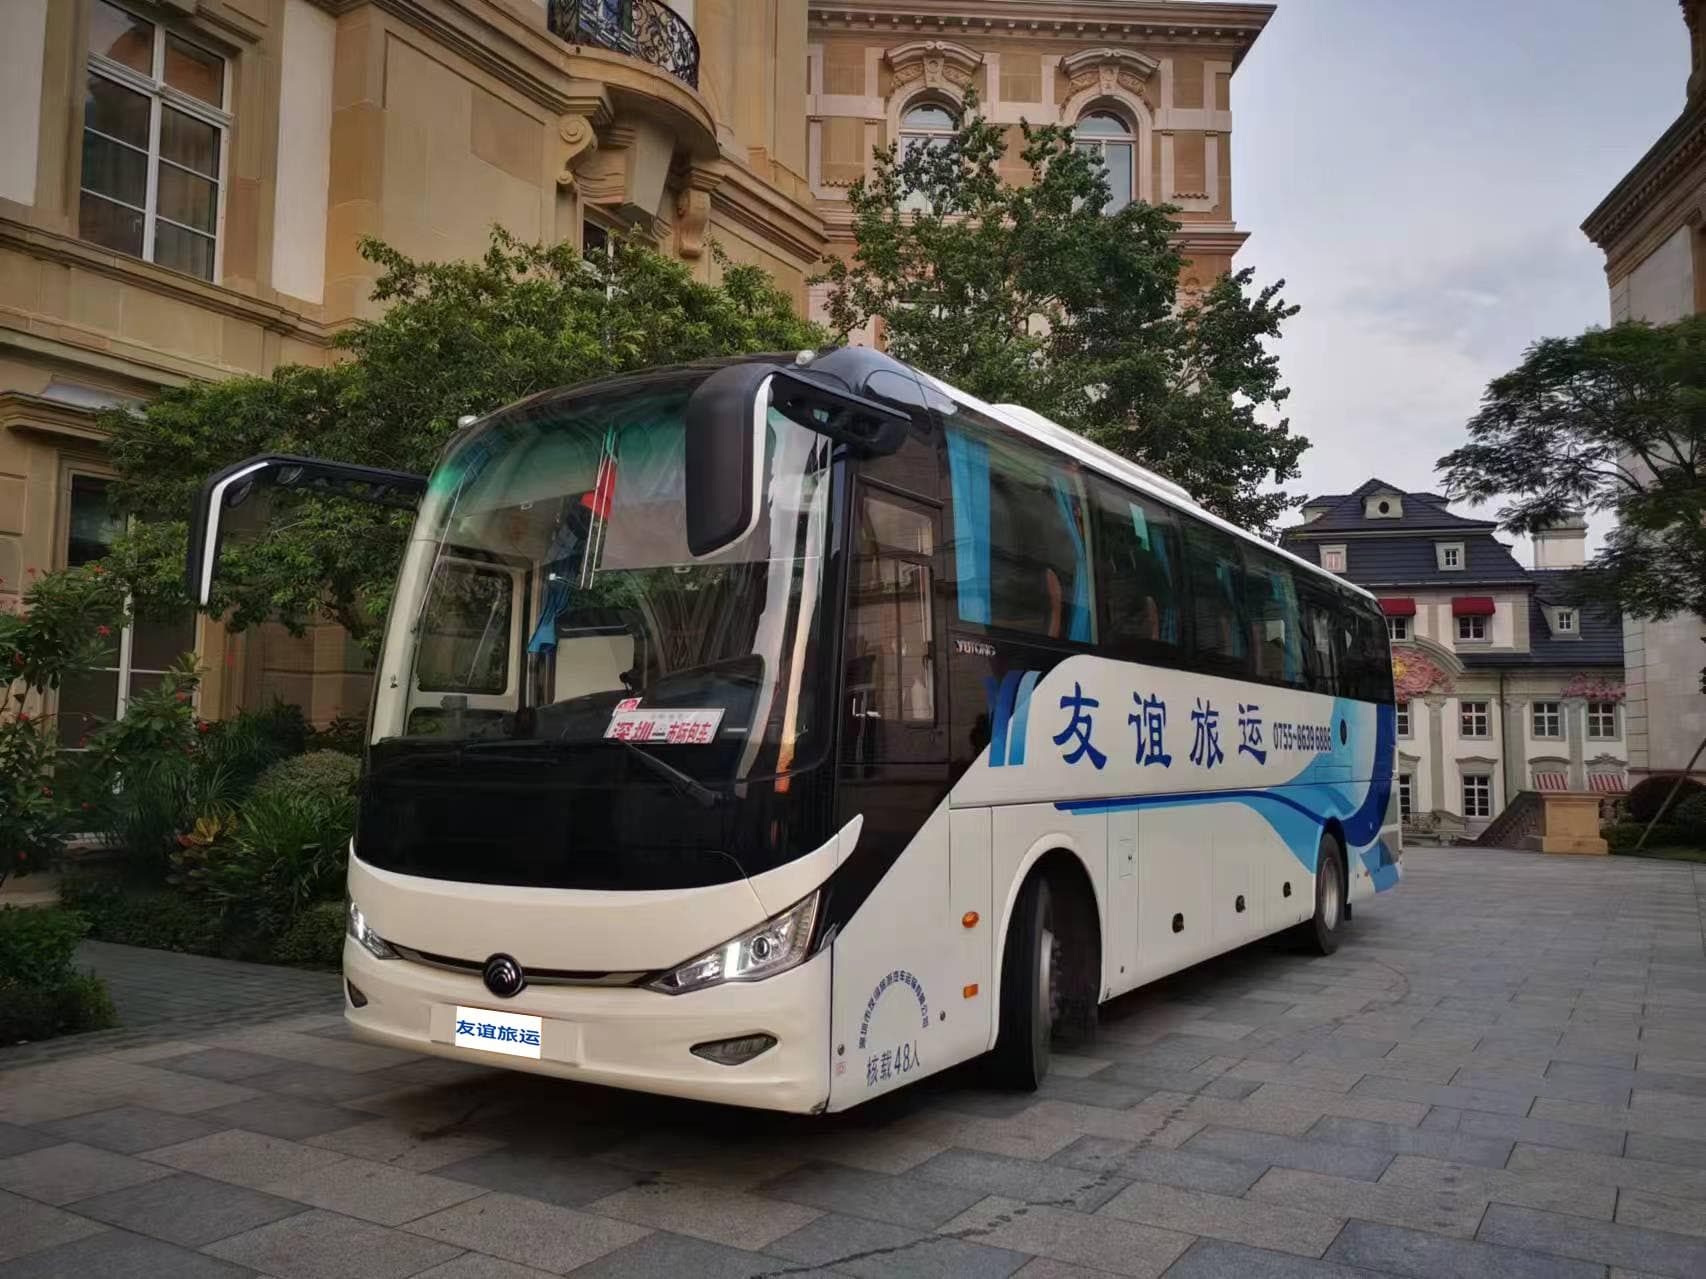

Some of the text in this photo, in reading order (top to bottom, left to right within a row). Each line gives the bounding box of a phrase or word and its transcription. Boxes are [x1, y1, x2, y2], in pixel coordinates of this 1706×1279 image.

[955, 639, 996, 656] YUTONG
[1052, 681, 1267, 771] 友谊旅运
[456, 1019, 541, 1046] 友谊旅运
[866, 1040, 920, 1087] 核载48人
